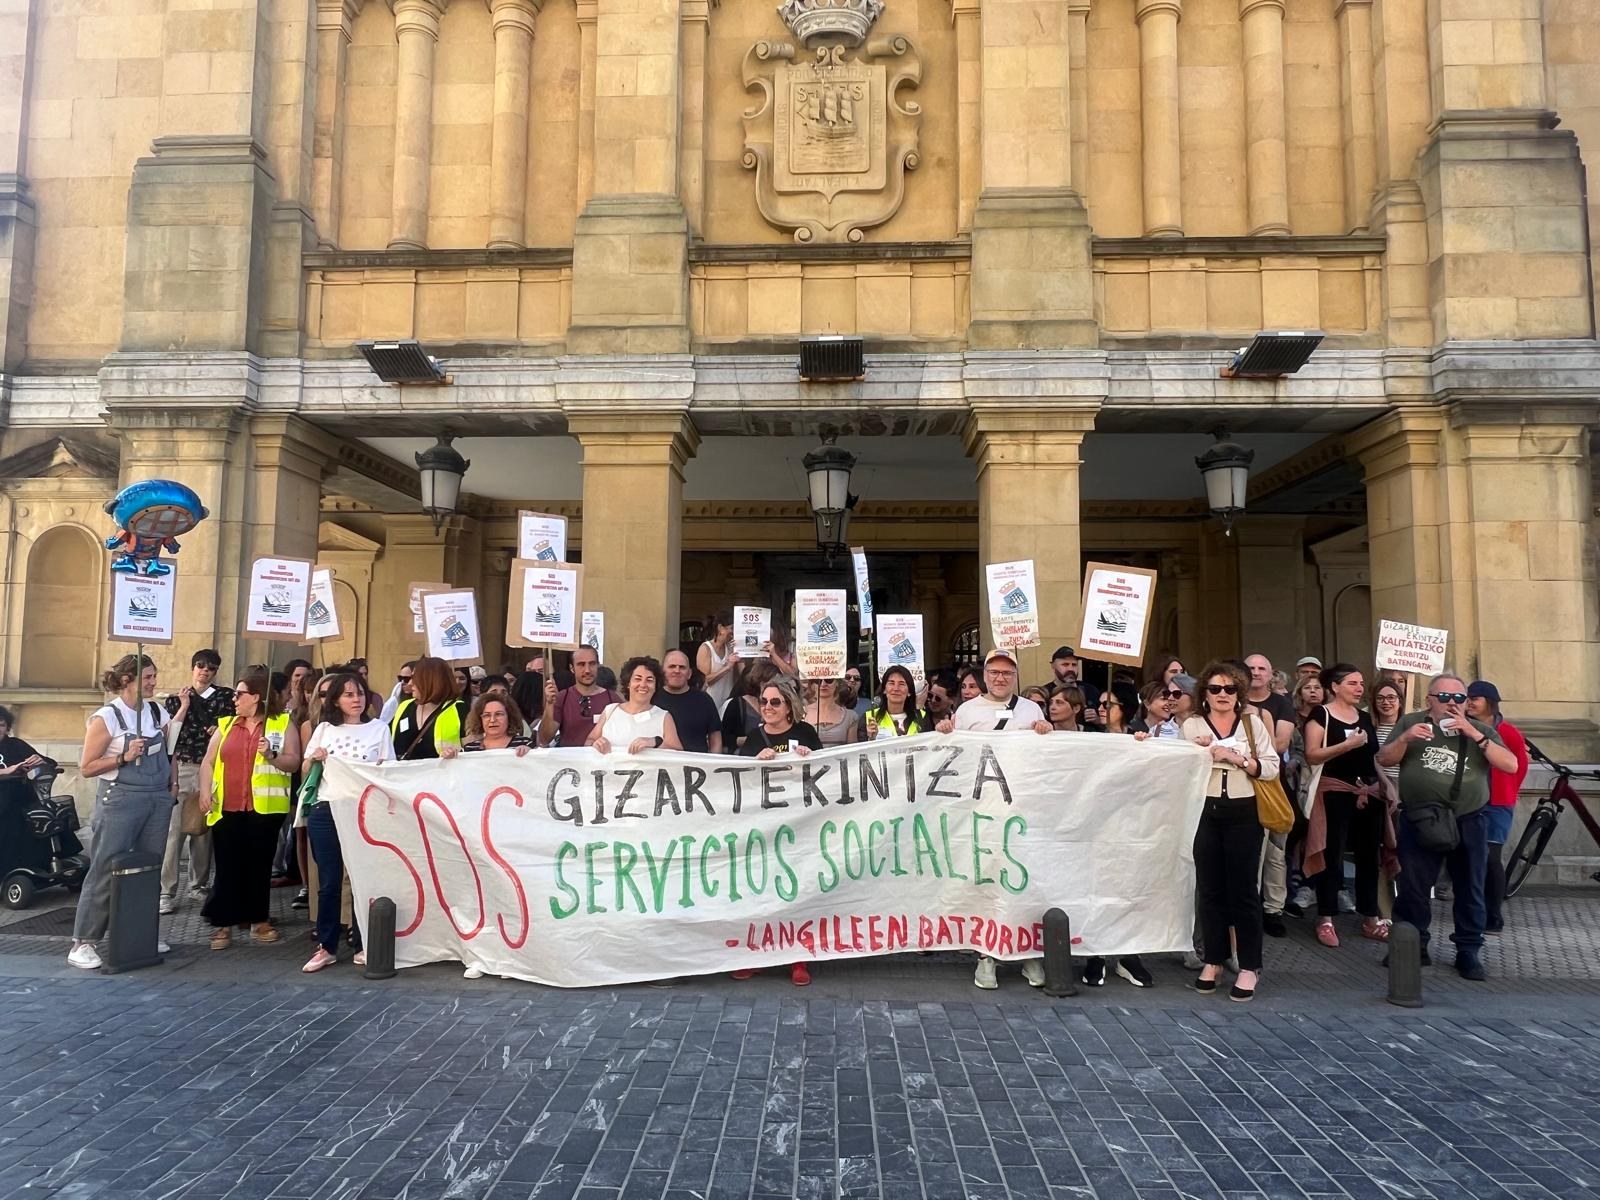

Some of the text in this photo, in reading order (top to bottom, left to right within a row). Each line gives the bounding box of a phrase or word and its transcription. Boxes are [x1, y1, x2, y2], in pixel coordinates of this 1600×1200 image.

[743, 613, 760, 622] SOS
[1380, 635, 1444, 654] KALITATEZKO
[1387, 657, 1433, 671] BATENGATIK
[1394, 649, 1430, 661] ZERBITZU
[546, 744, 1013, 827] GIZARTEKINTZA
[357, 783, 530, 950] SOS
[549, 827, 798, 920] SERVICIOS
[817, 811, 1030, 896] SOCIALES
